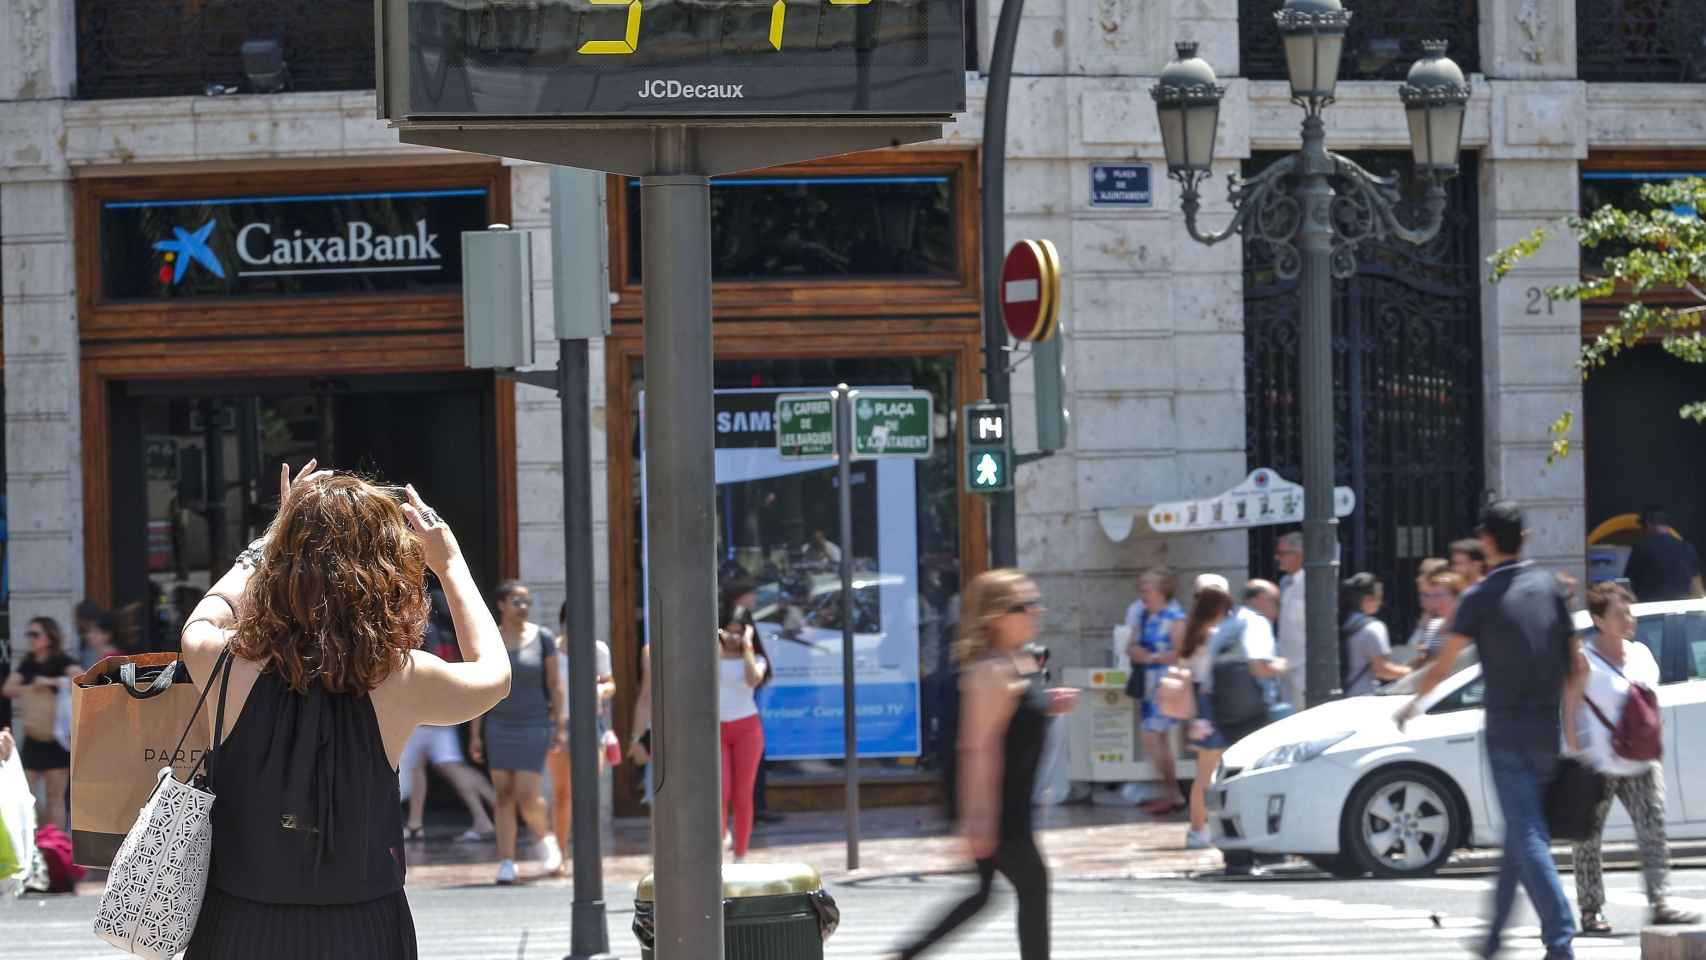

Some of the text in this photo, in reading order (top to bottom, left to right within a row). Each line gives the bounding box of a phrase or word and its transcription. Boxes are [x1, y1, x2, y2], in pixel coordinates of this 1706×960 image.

[638, 80, 744, 98] JCDecaux
[236, 219, 441, 265] CaixaBank
[874, 402, 915, 419] PLAÇA
[800, 417, 812, 430] DE
[979, 416, 1003, 439] 14
[144, 748, 203, 763] PARF
